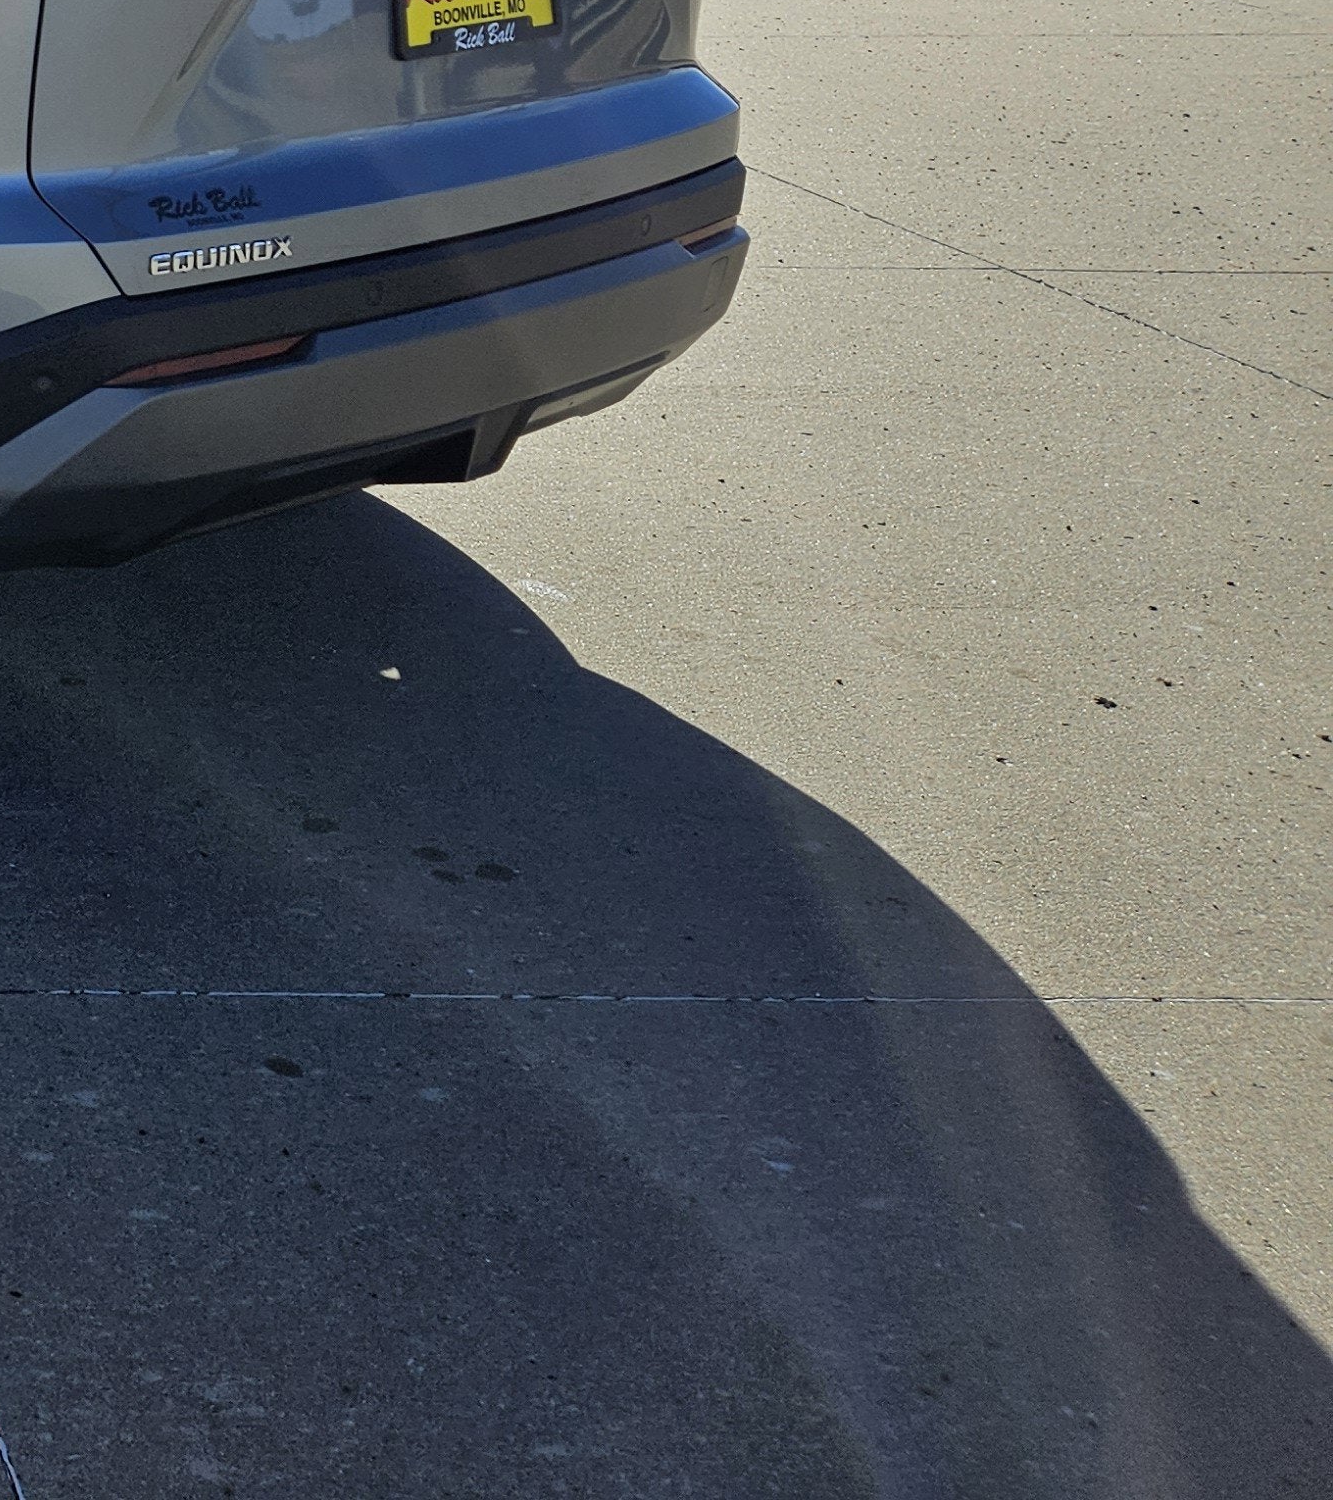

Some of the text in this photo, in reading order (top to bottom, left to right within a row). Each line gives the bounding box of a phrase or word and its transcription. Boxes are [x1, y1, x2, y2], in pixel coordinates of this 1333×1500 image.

[434, 0, 506, 26] BOONVILLE,
[454, 22, 515, 52] Rick Ball
[148, 185, 262, 223] Rick Ball
[149, 235, 293, 276] EQUINOX
